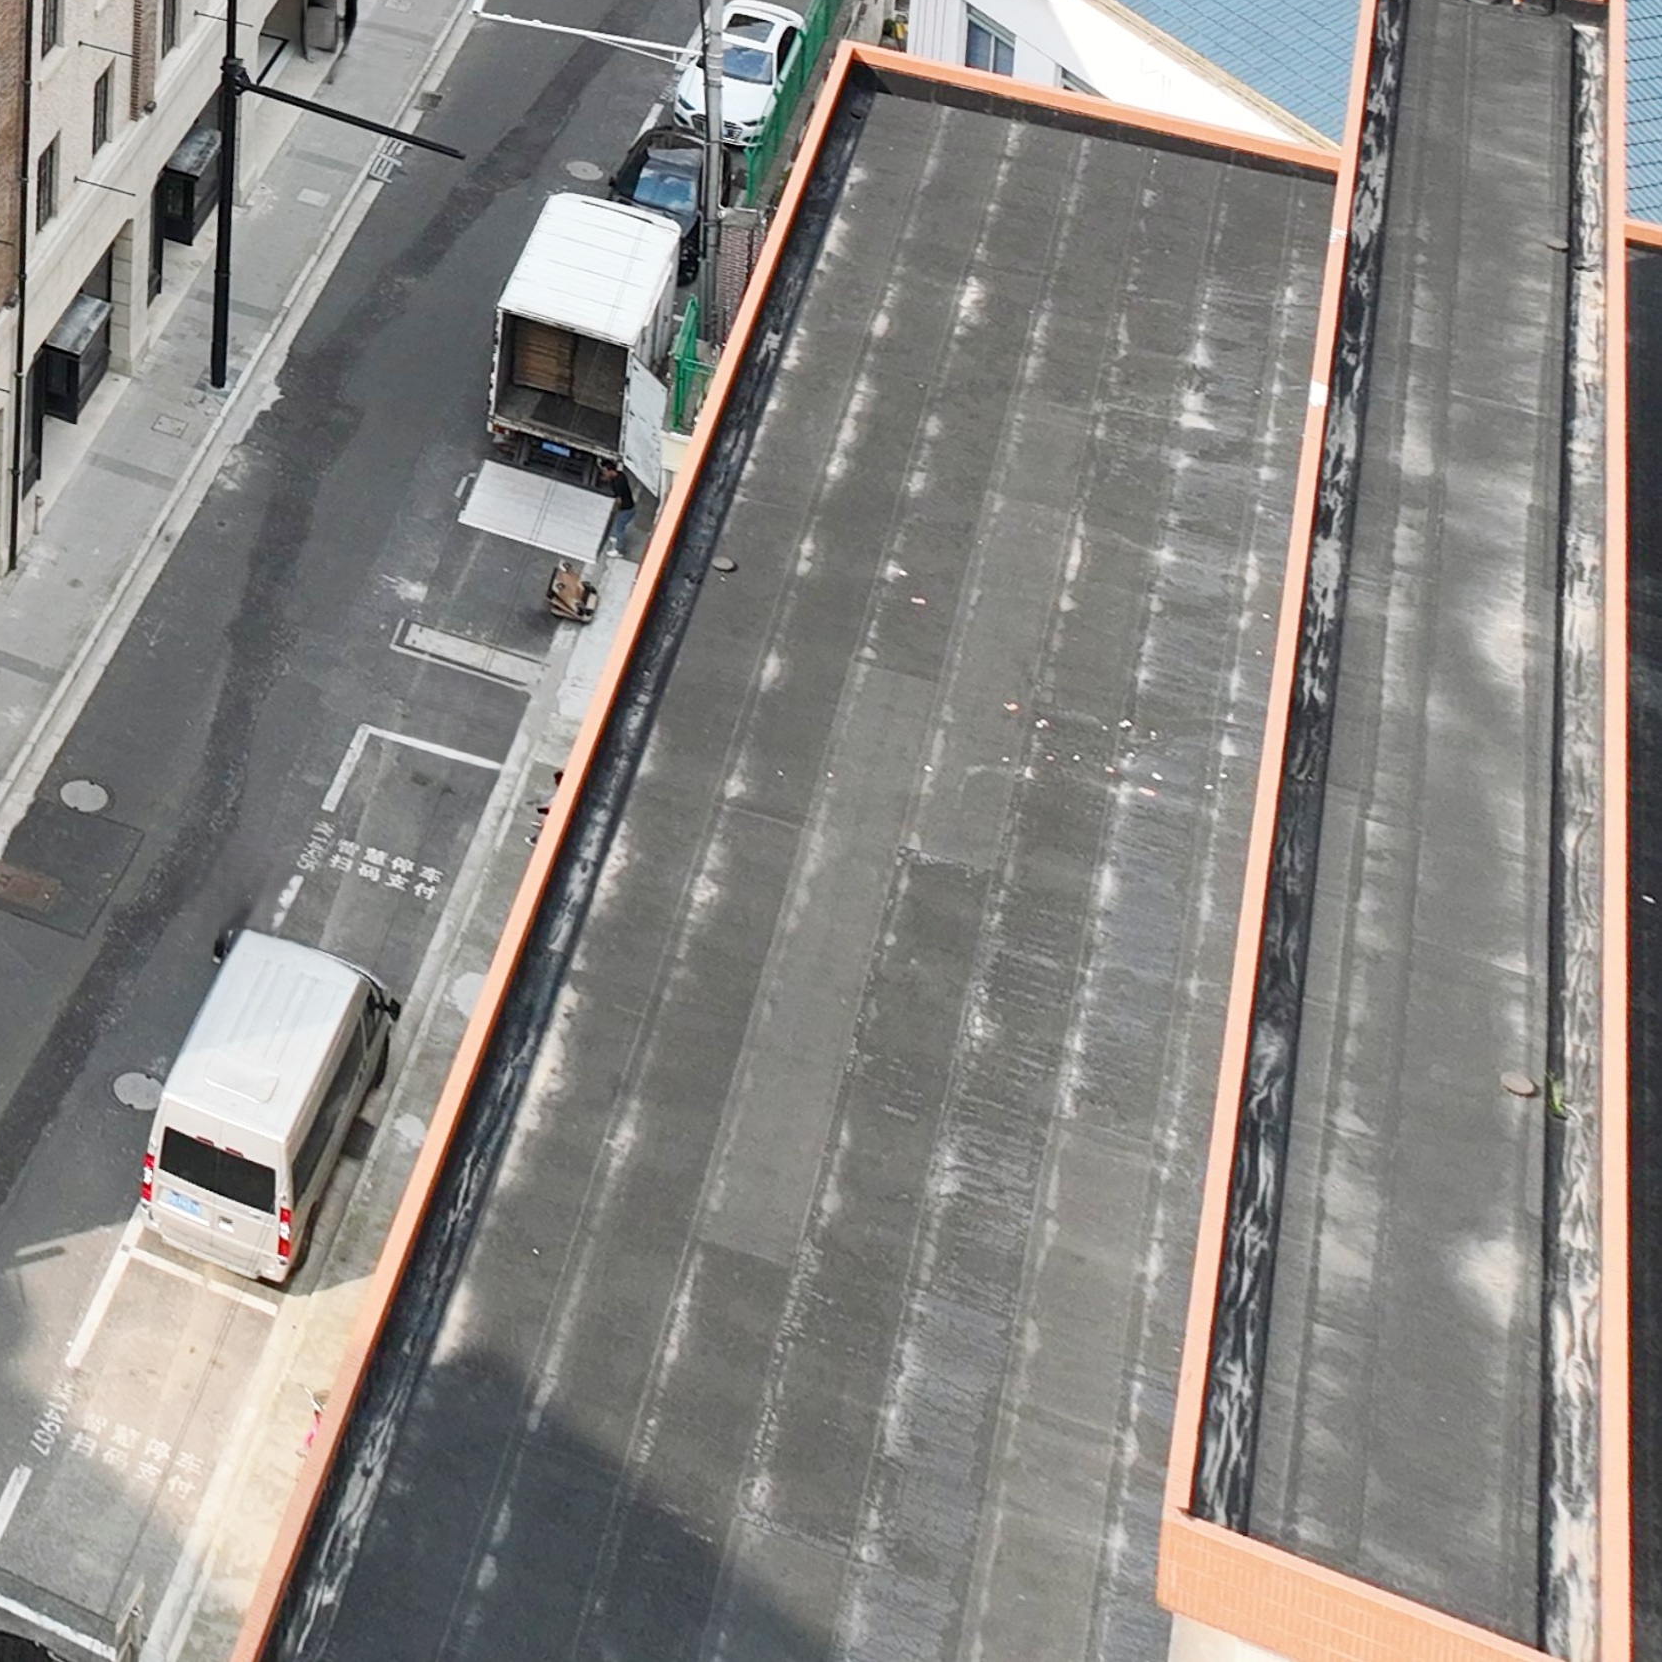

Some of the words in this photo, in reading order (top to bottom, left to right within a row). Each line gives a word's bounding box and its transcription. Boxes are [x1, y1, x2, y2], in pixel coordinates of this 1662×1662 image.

[328, 853, 439, 901] 扫码支付
[69, 1430, 197, 1501] 扫码支付
